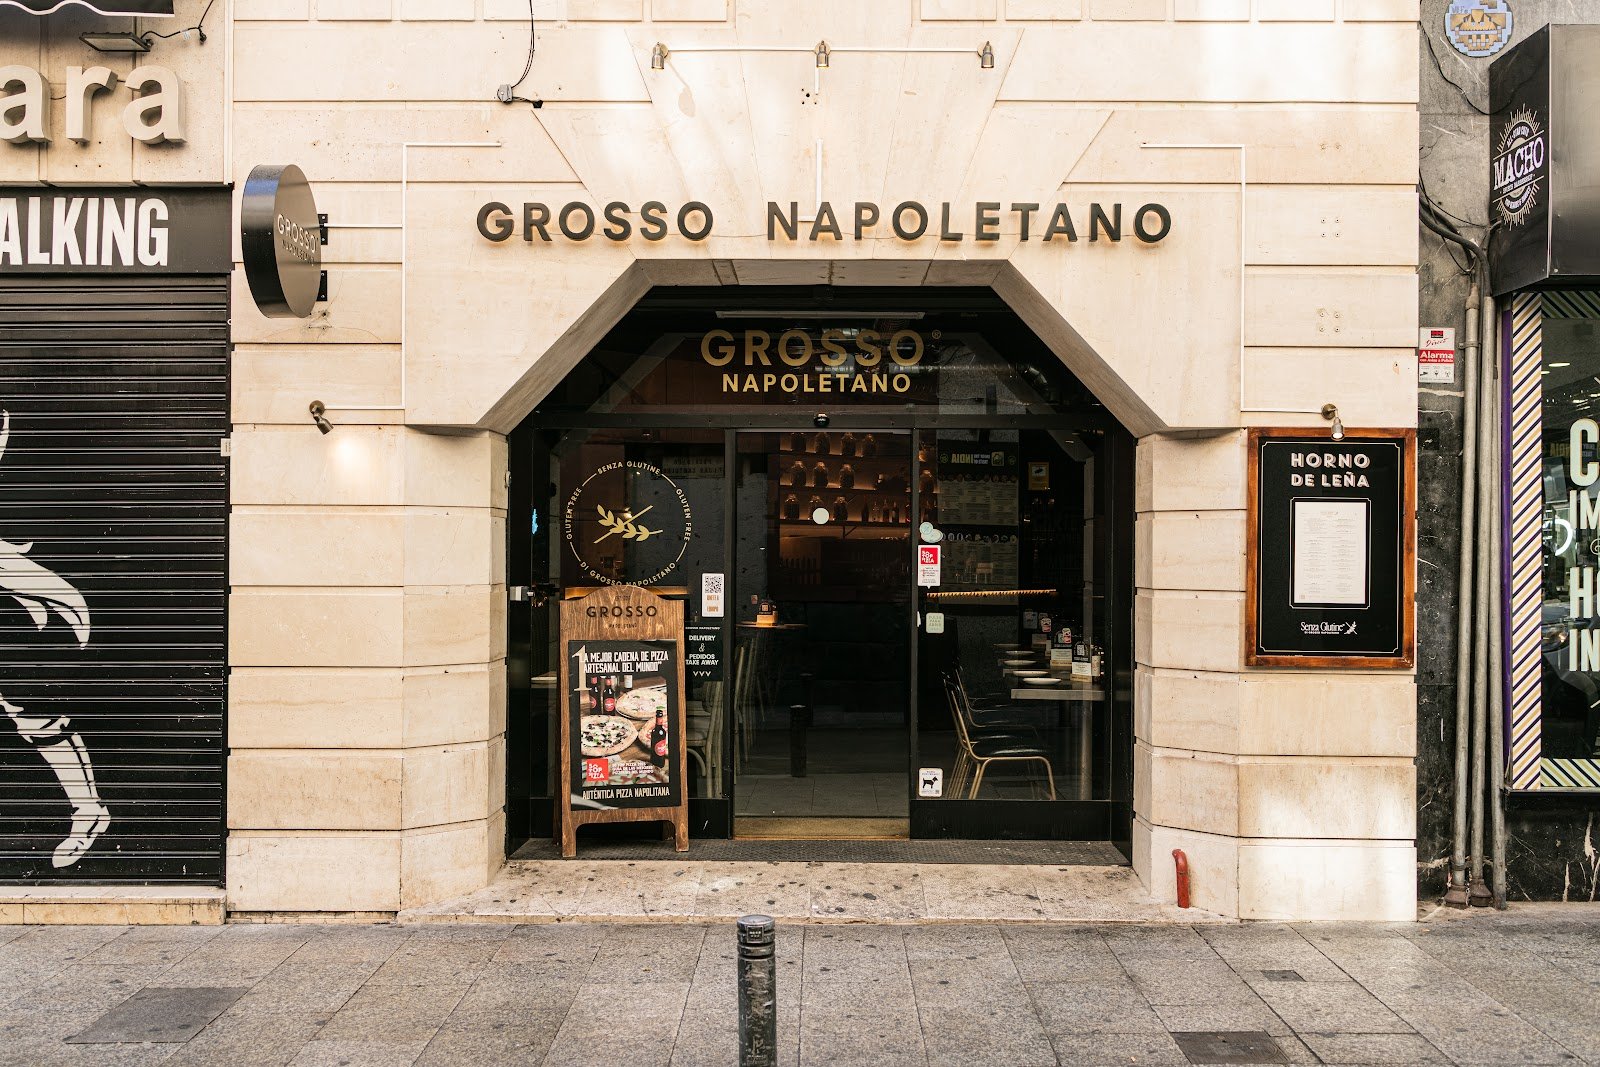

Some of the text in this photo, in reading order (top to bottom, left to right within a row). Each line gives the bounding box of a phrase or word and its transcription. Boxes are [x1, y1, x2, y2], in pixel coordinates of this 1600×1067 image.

[0, 64, 187, 145] ara
[1494, 137, 1544, 190] MACHO
[0, 196, 169, 267] ALKING
[476, 200, 1172, 244] GROSSO NAPOLETANO
[278, 213, 316, 254] GROSSO
[700, 328, 925, 367] GROSSO
[1420, 351, 1454, 359] Alarma
[721, 373, 912, 394] NAPOLETANO
[598, 462, 624, 475] SENZA
[626, 461, 660, 475] GLUTINE
[1290, 452, 1371, 468] HORNO
[1291, 471, 1370, 488] DE LEÑA
[675, 488, 692, 541] GLUTEN FREE
[580, 561, 676, 587] DI GROSSO NAPOLETANO
[1570, 566, 1600, 619] H
[586, 605, 657, 618] GROSSO
[1300, 621, 1319, 631] Senza
[590, 652, 612, 662] MEJOR
[613, 651, 639, 662] CADENA
[640, 651, 649, 661] DE
[650, 650, 669, 661] PIZZA
[699, 642, 706, 652] &
[584, 662, 620, 673] ARTESANAL
[621, 662, 634, 672] DEL
[582, 786, 670, 800] AUTÉNTICA PIZZA NAPOLITANA
